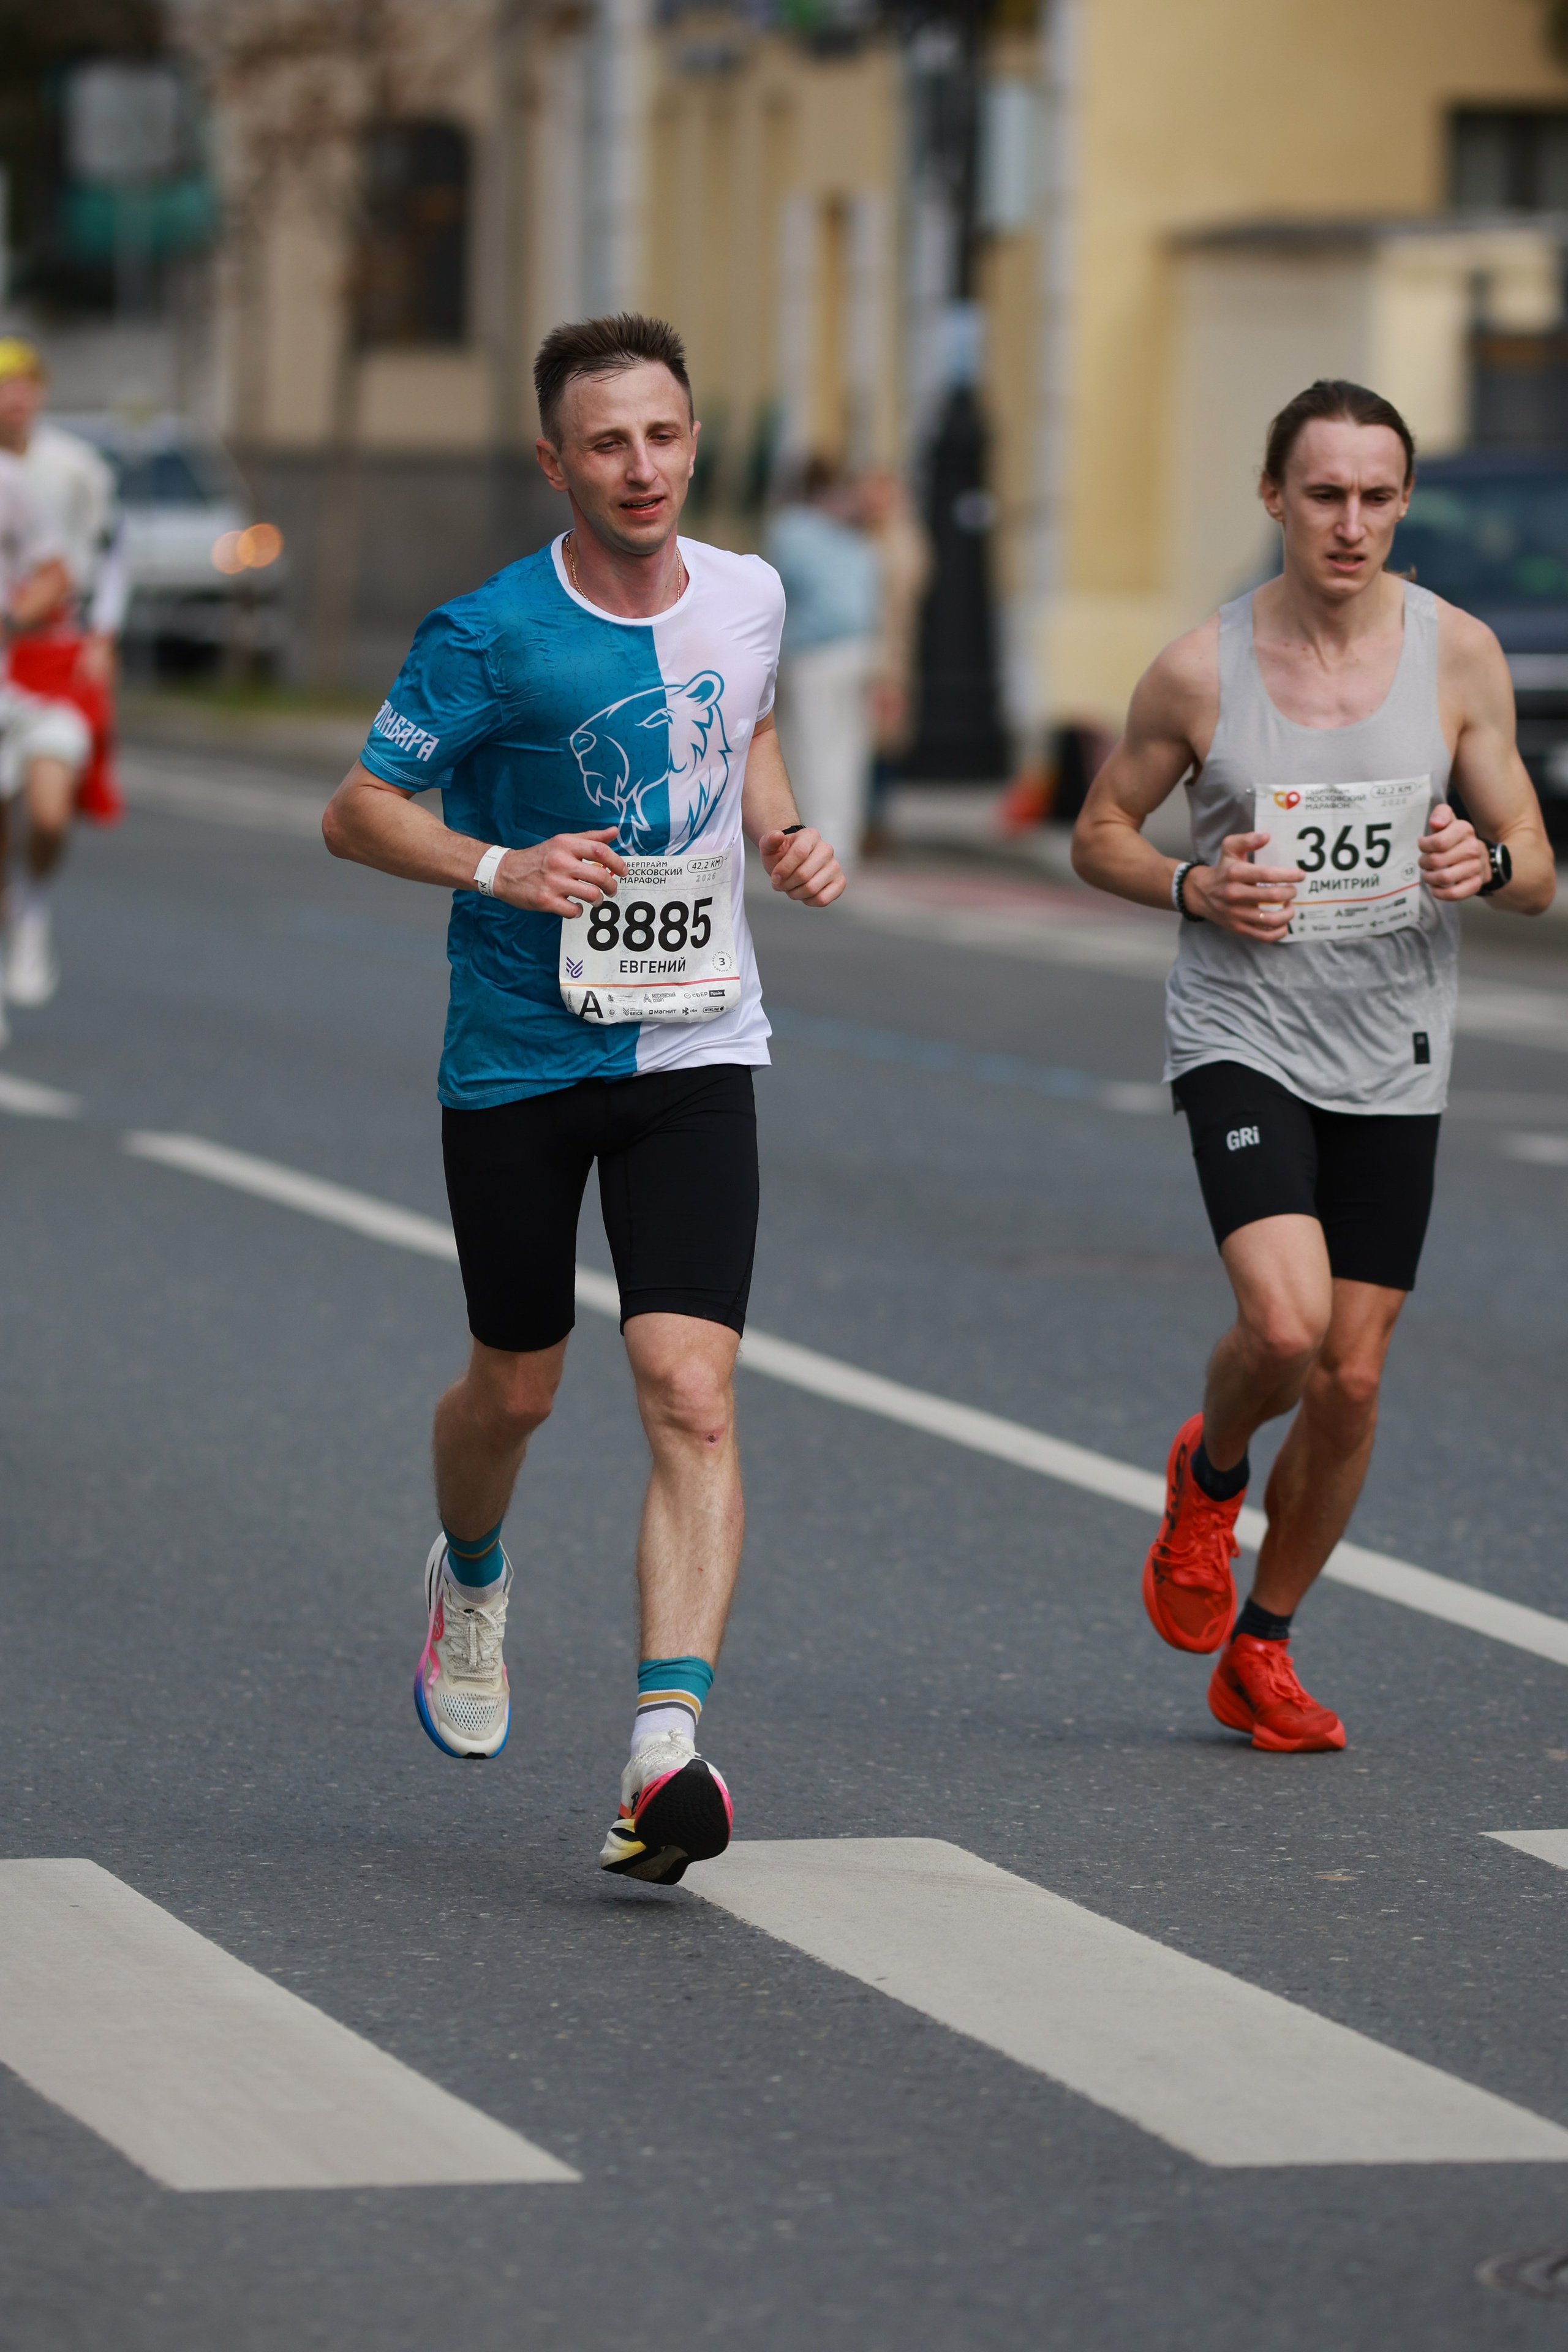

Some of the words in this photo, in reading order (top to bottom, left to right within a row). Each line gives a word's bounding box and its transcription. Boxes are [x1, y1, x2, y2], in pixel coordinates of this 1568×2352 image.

[1296, 823, 1392, 872] 365
[628, 867, 682, 876] ОСКОВСКИЙ
[692, 861, 709, 870] 42,2
[710, 859, 721, 868] КМ
[1309, 874, 1379, 894] ДМИТРИЙ
[587, 896, 713, 952] 8885
[619, 957, 686, 973] ЕВГЕНИЙ
[718, 957, 726, 966] 3
[1227, 1126, 1261, 1151] GRi
